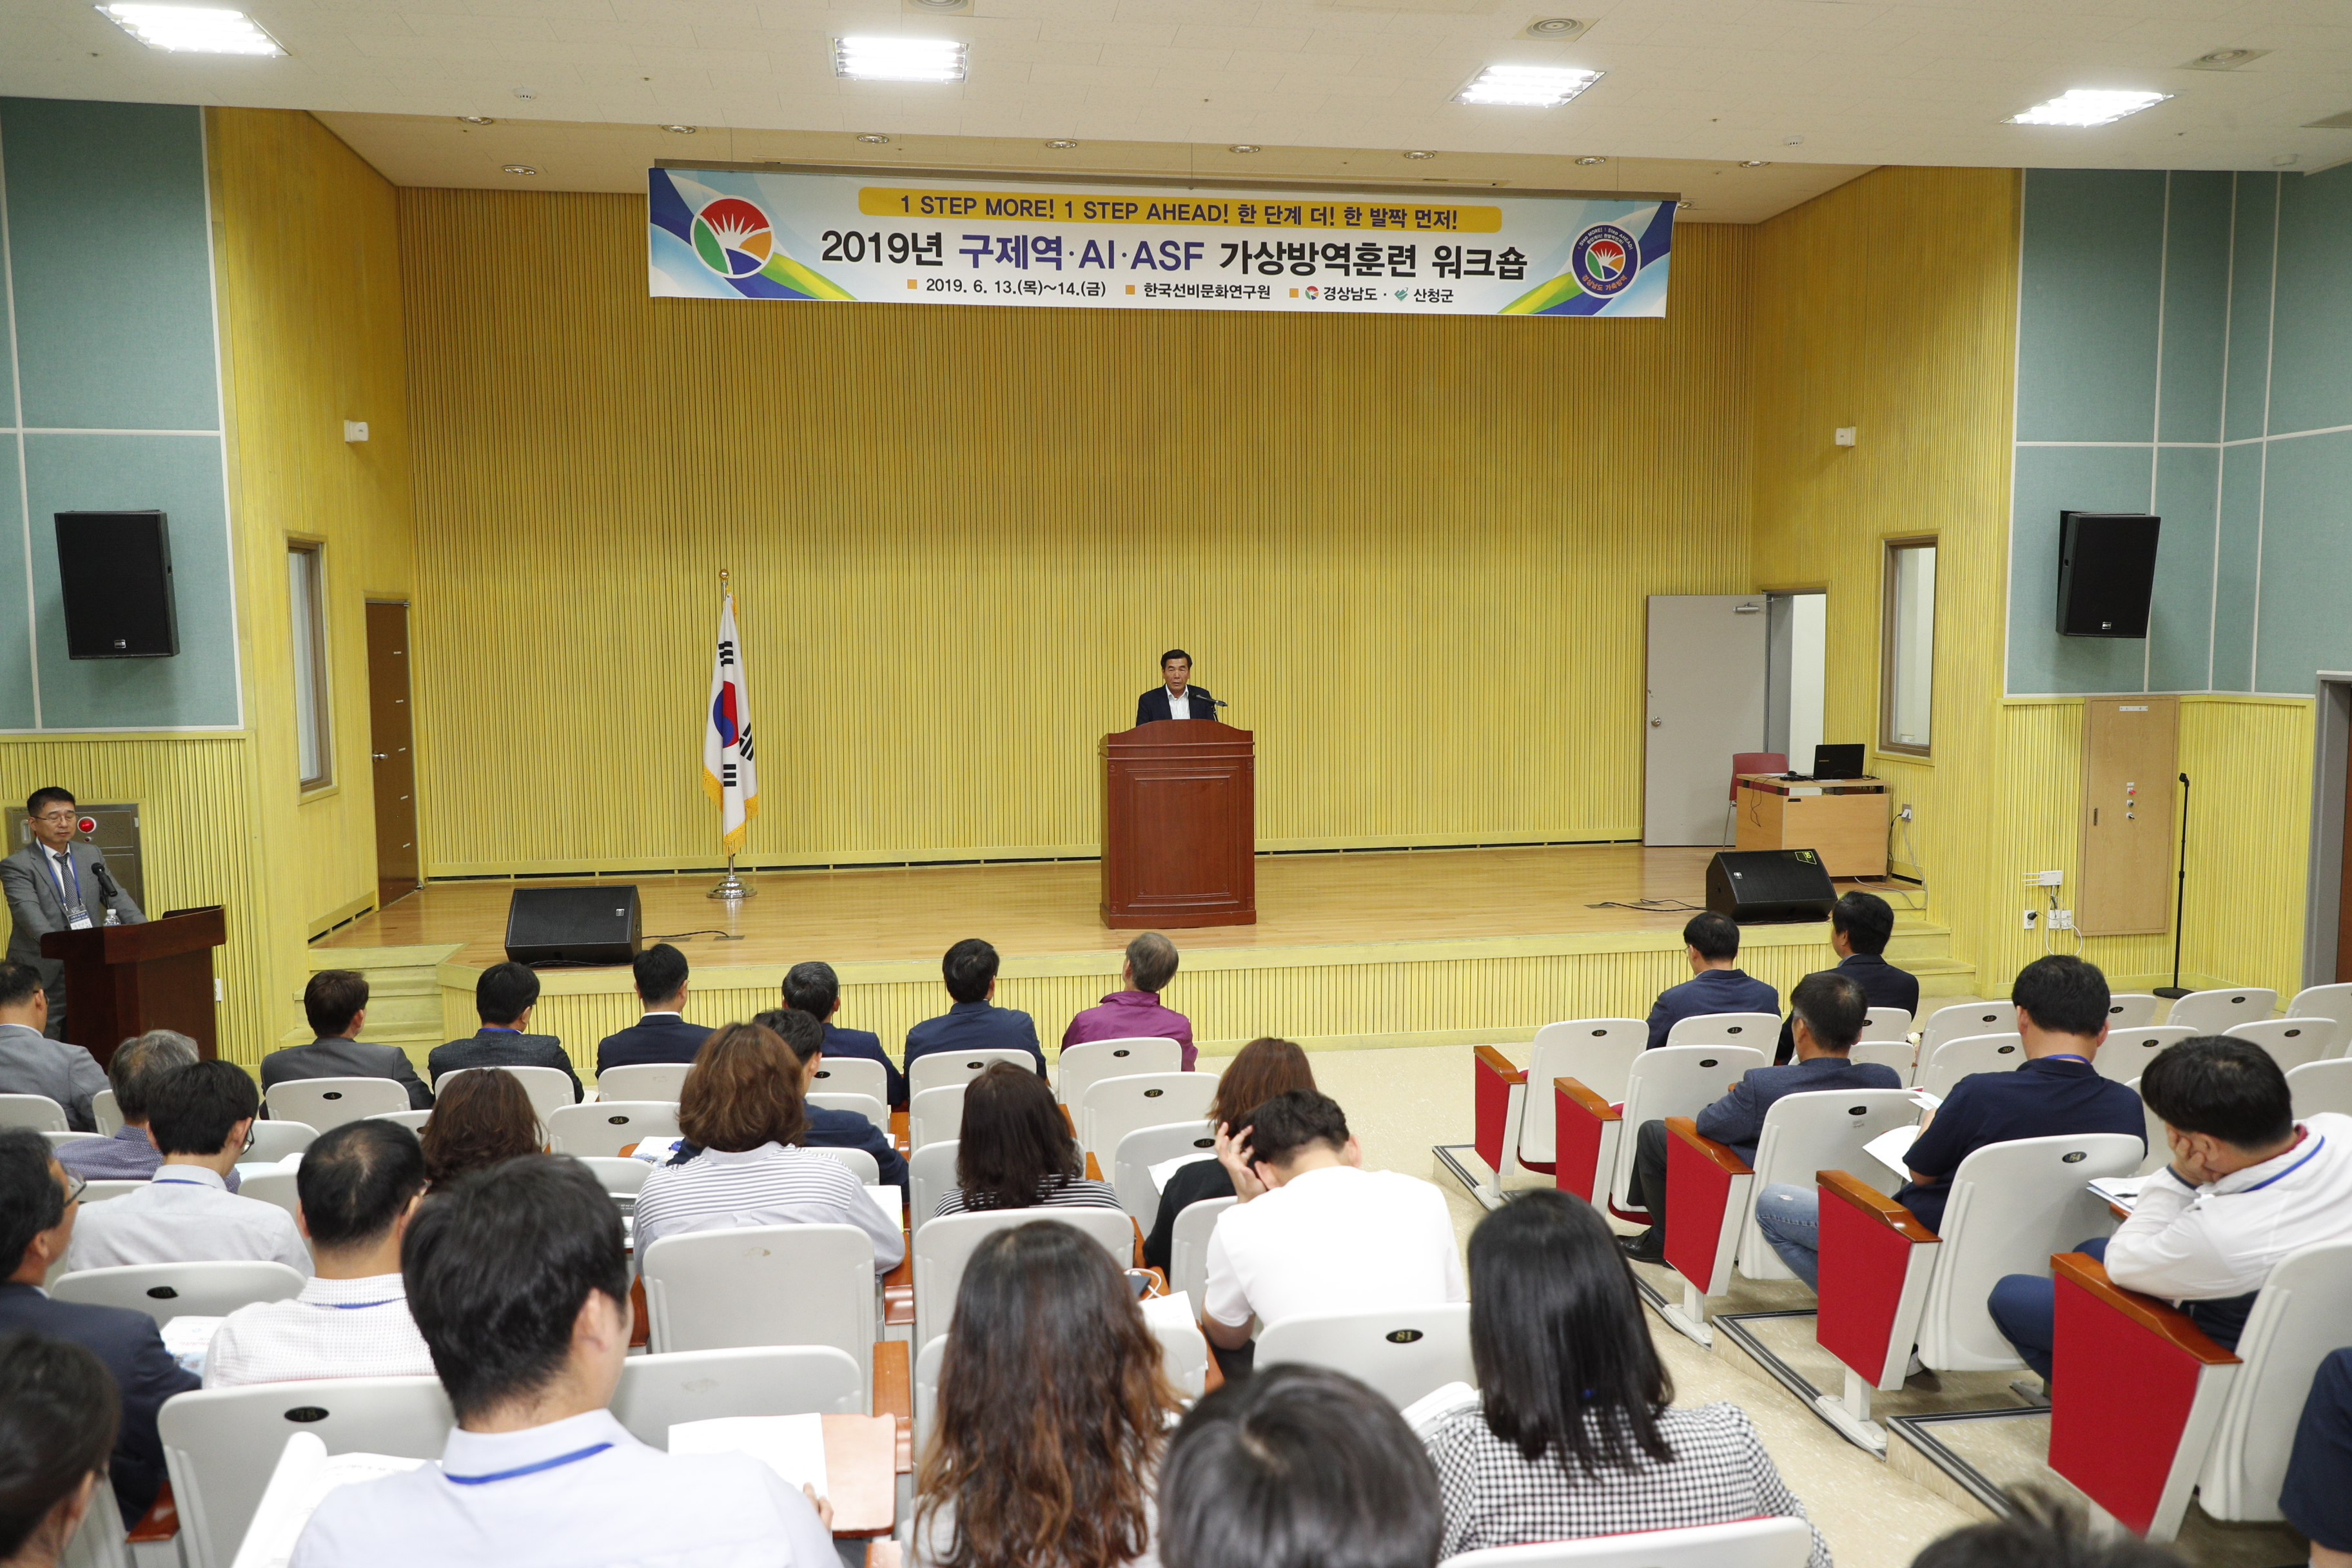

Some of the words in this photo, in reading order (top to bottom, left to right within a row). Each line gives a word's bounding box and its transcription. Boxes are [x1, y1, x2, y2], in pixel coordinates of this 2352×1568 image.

[901, 195, 909, 213] 1
[920, 195, 977, 215] STEP
[985, 198, 1054, 219] MORE!
[1064, 201, 1072, 219] 1
[1083, 201, 1139, 220] STEP
[1146, 203, 1228, 224] AHEAD!
[1237, 204, 1257, 224] 한
[1264, 205, 1302, 226] 단계
[1310, 206, 1335, 226] 더!
[1344, 206, 1363, 227] 한
[1369, 208, 1408, 228] 발짝
[1415, 209, 1457, 230] 먼저!
[821, 230, 943, 267] 2019년
[1219, 240, 1416, 278] 가상방역훈련
[1432, 245, 1528, 280] 워크숍
[926, 278, 967, 293] 2019.
[973, 279, 988, 294] 6.
[1143, 282, 1271, 300] 한국선비문화연구원
[1582, 275, 1603, 291] 경상남도
[1605, 275, 1627, 291] 가축방역
[1323, 286, 1378, 301] 경상남도
[1413, 288, 1454, 303] 산청군
[2068, 1153, 2081, 1161] 64
[1395, 1331, 1413, 1341] 81
